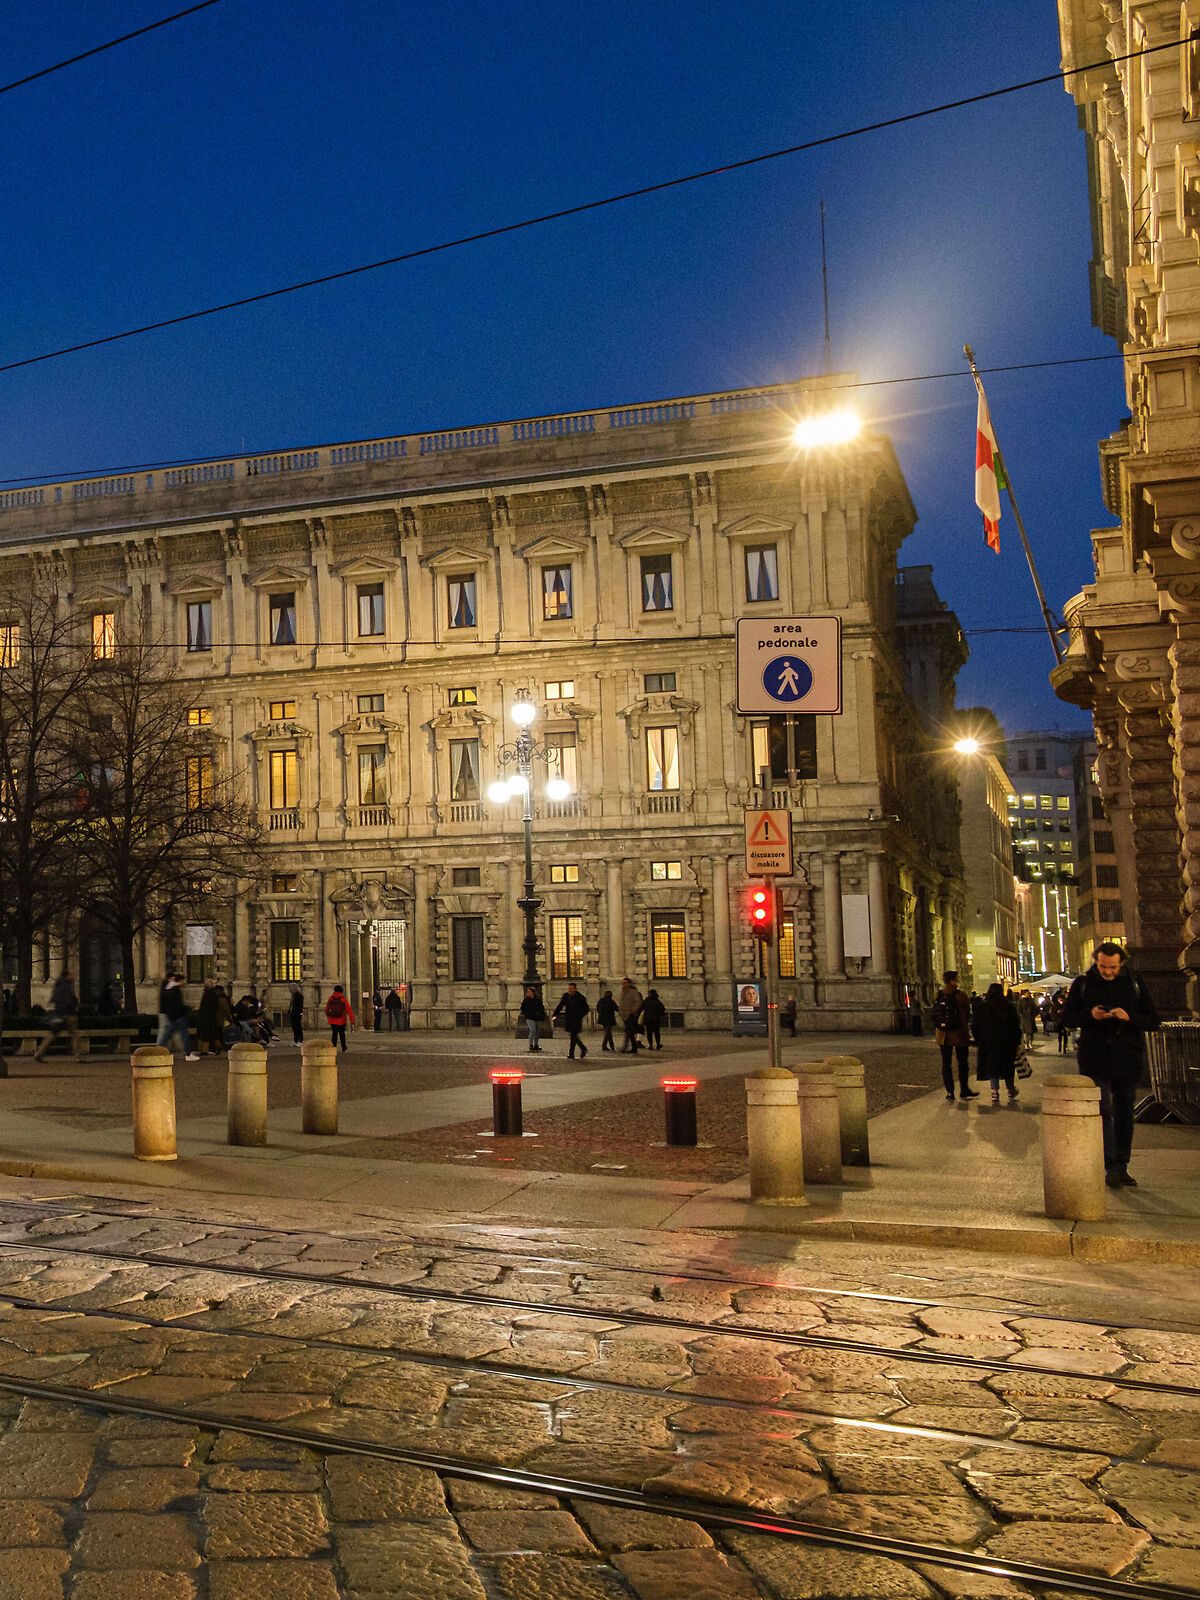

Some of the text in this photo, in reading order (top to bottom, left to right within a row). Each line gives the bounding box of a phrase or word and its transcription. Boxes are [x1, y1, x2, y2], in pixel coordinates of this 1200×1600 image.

[773, 625, 802, 633] area
[758, 637, 818, 650] pedonale
[756, 860, 780, 868] mobile
